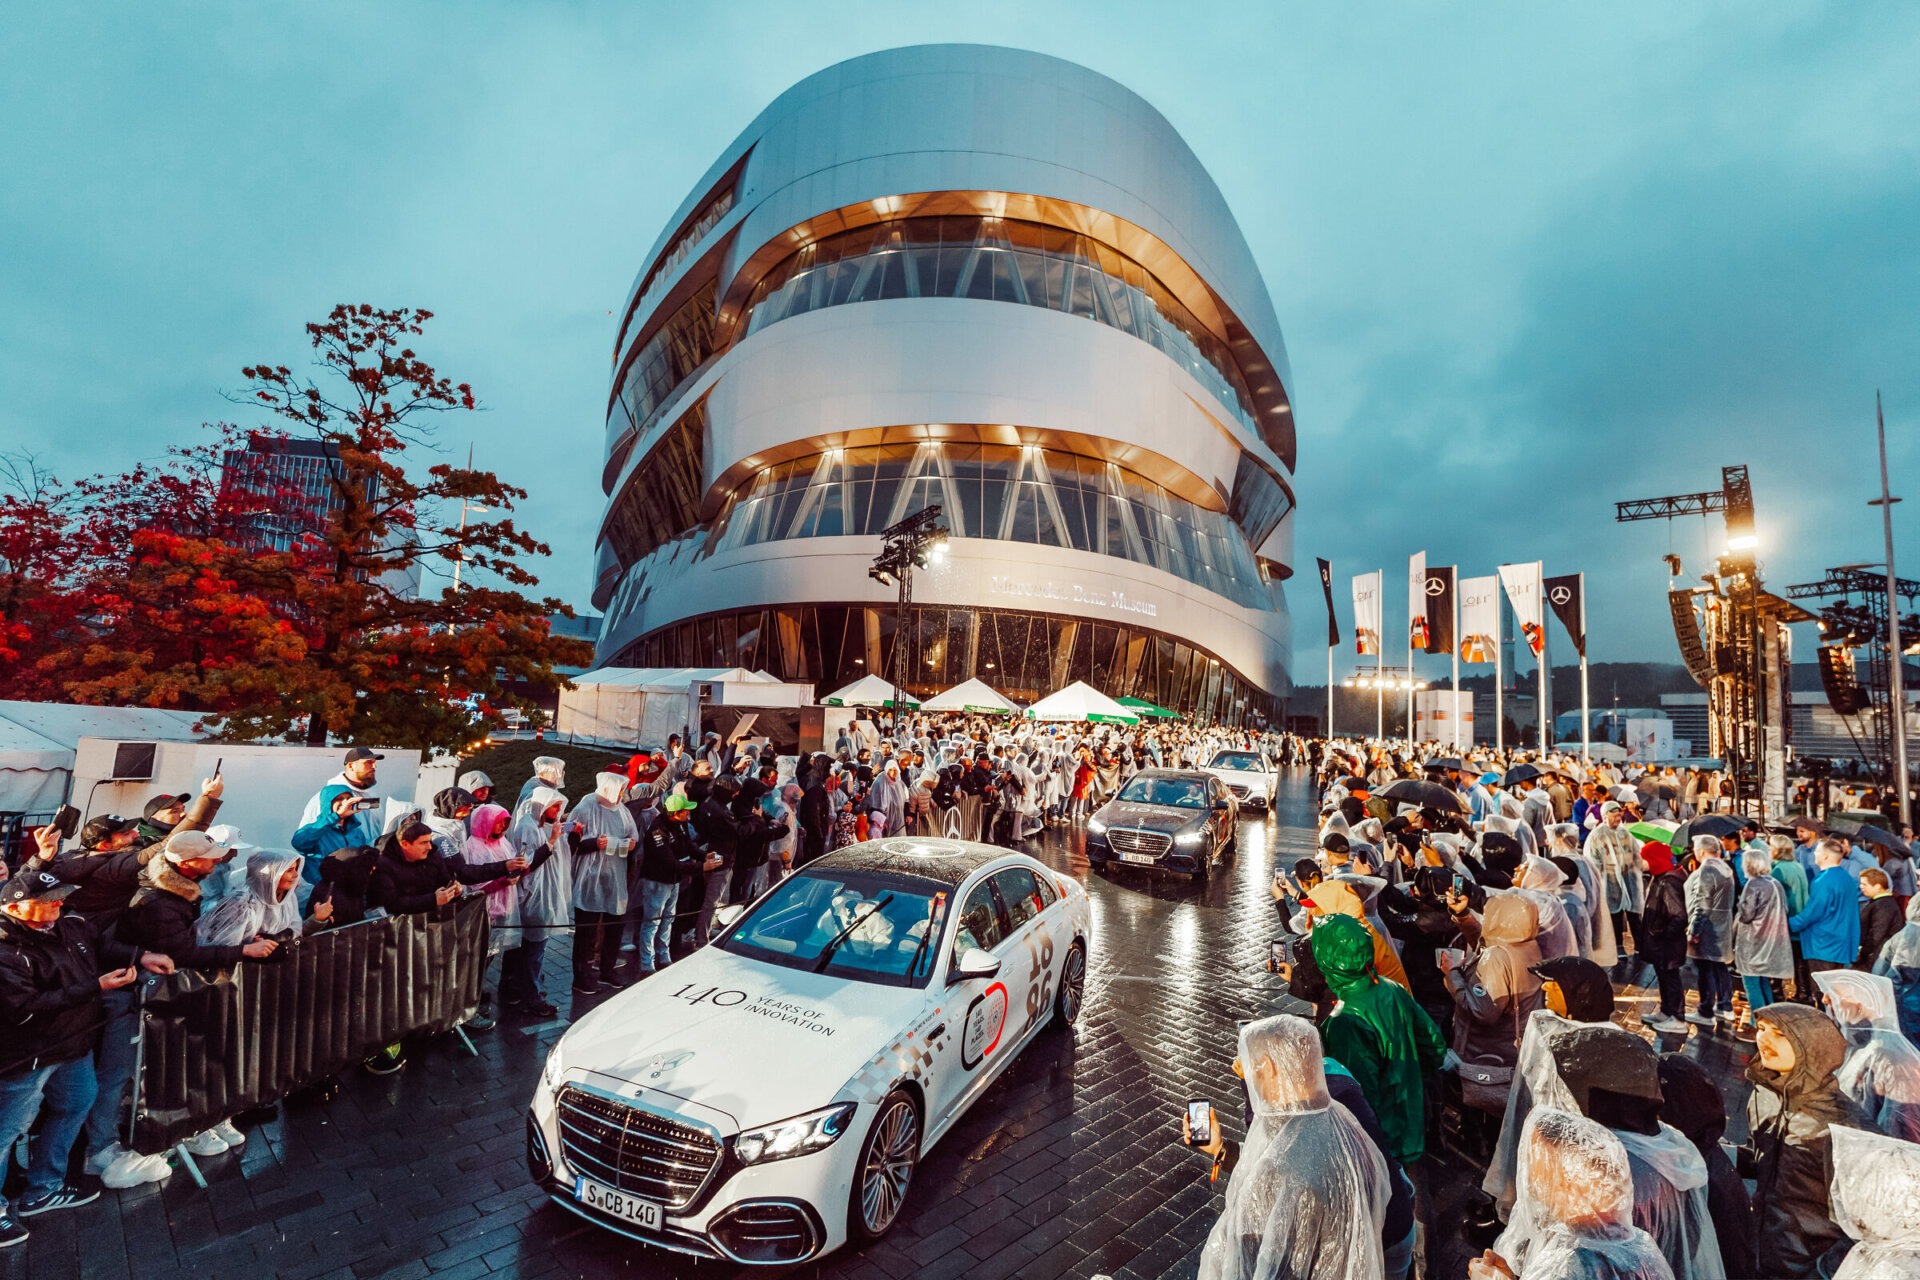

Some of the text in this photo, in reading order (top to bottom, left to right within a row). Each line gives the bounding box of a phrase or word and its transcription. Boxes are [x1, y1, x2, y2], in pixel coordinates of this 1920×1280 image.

[1111, 591, 1157, 617] Museum
[1120, 805, 1150, 813] 140
[1022, 920, 1054, 983] 18
[667, 983, 748, 1007] 140
[757, 996, 826, 1020] YEARS OF
[744, 1004, 836, 1037] INNOVATION
[588, 1184, 655, 1225] S CB 140
